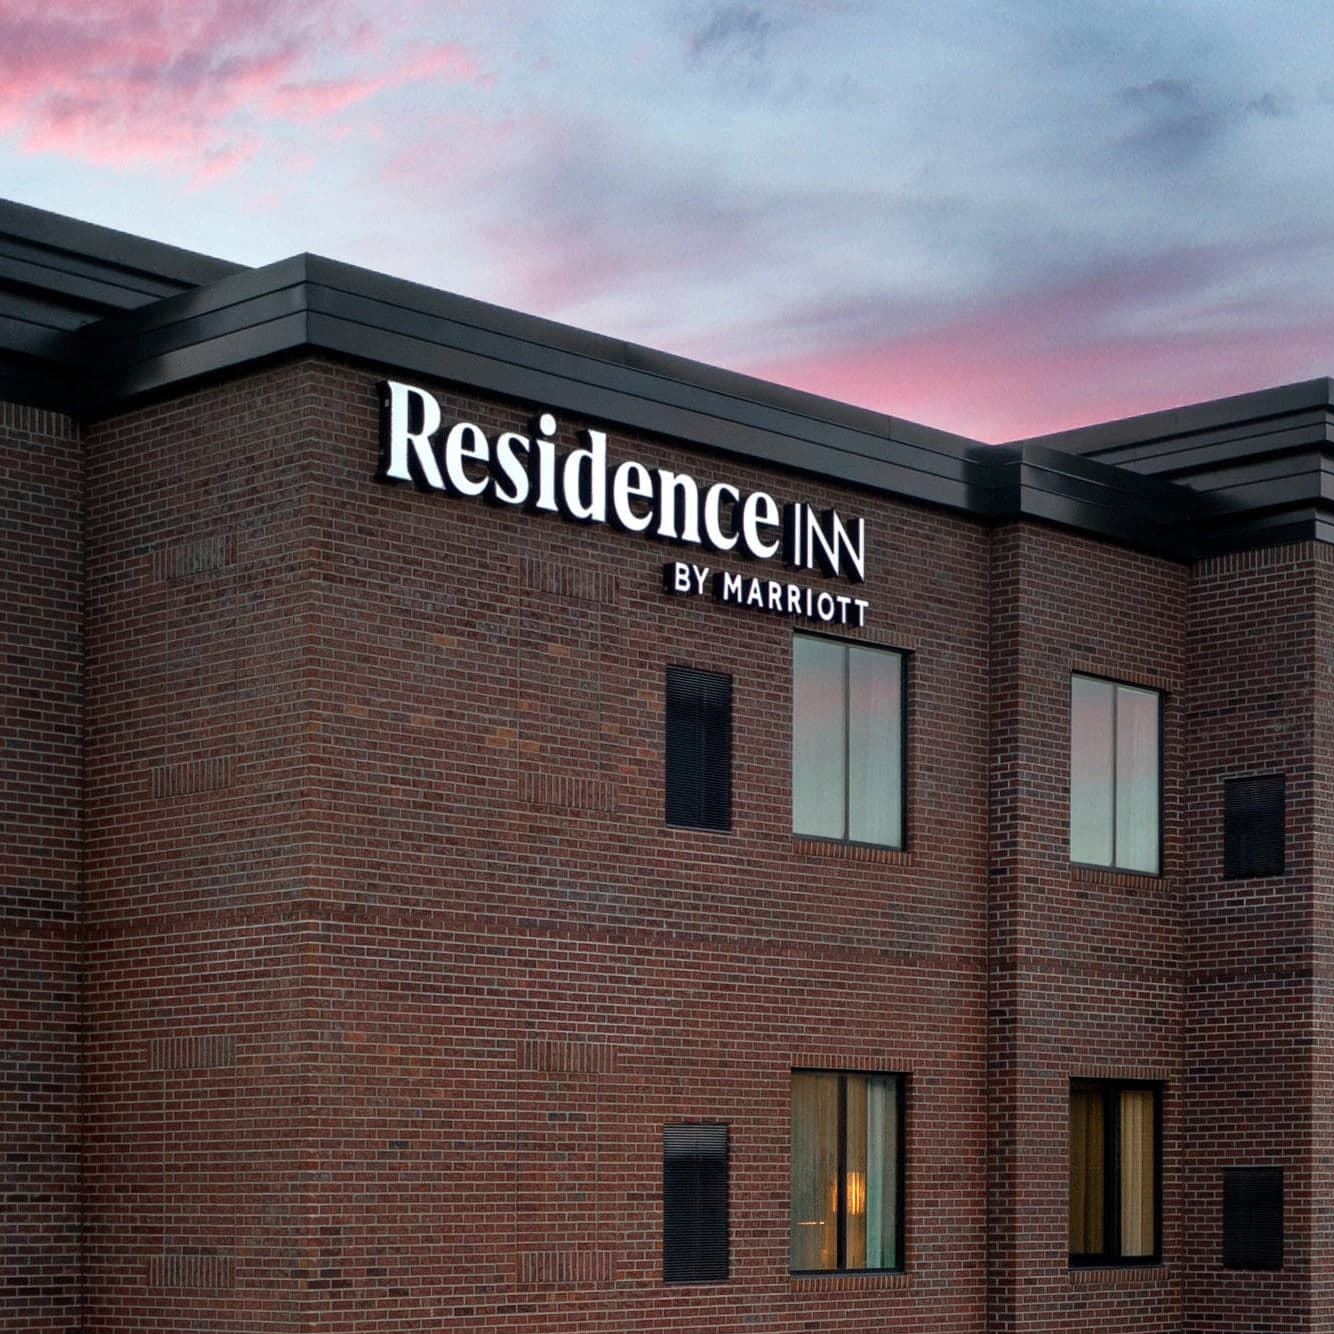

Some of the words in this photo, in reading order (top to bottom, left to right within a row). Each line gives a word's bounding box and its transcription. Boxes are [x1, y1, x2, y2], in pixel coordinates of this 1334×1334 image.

[386, 379, 780, 559] Residence
[794, 502, 865, 583] INN
[674, 562, 709, 594] BY
[723, 574, 869, 627] MARRIOTT
